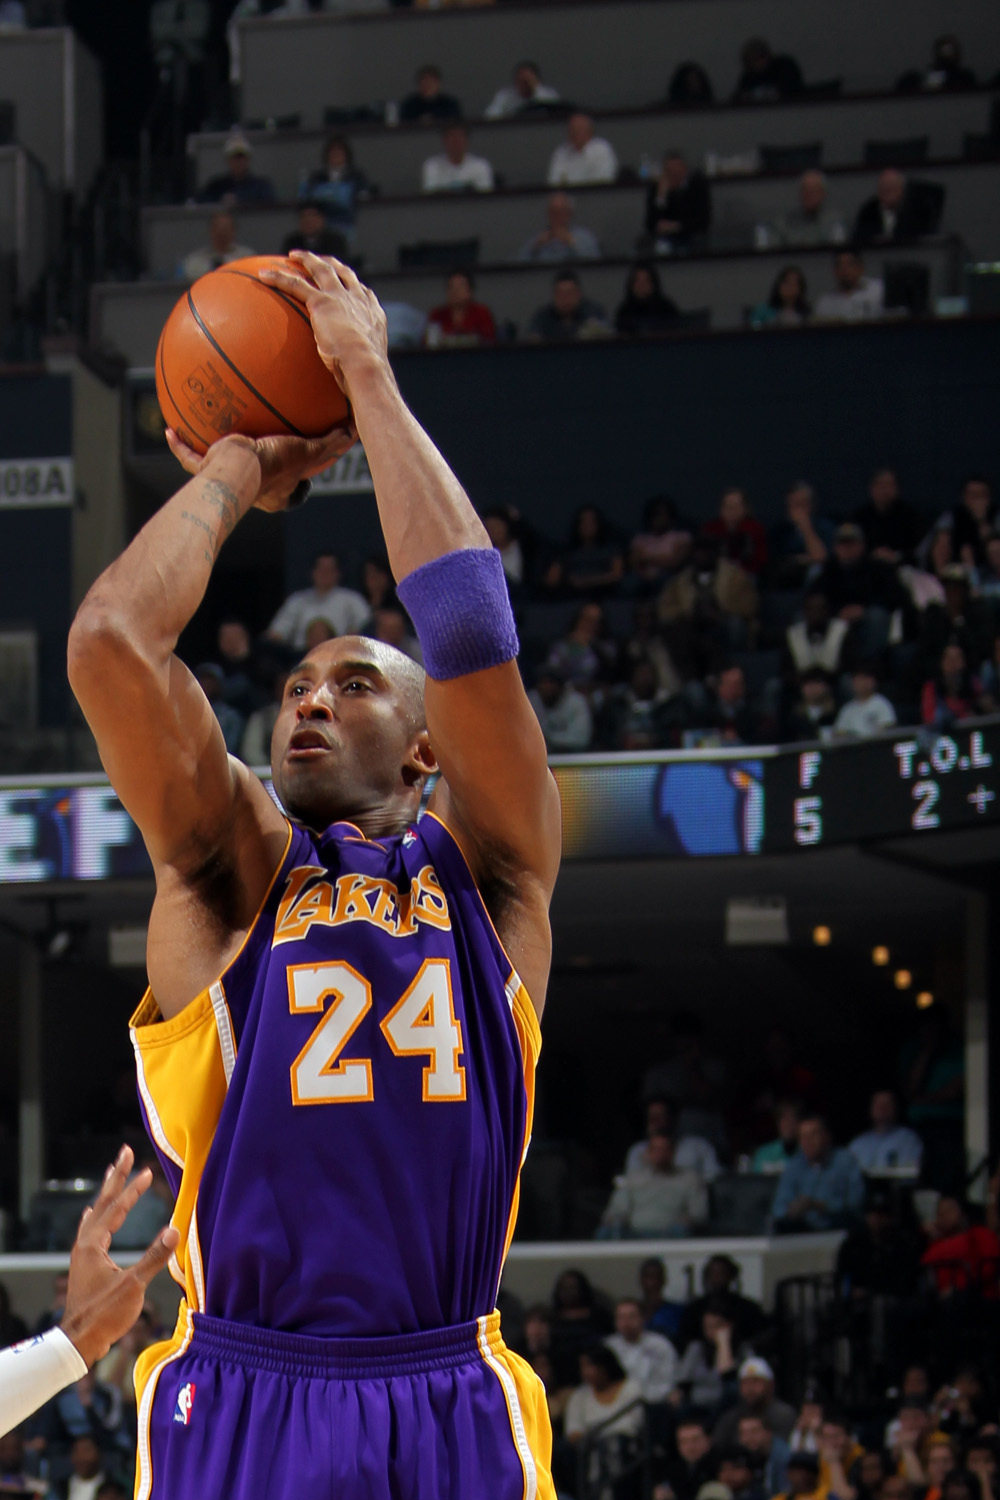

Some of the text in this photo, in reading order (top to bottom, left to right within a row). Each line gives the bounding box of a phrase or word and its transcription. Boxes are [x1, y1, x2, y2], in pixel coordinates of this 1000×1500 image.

[800, 752, 821, 788] F
[795, 796, 822, 845] 5
[912, 780, 940, 829] 2
[286, 957, 467, 1106] 24
